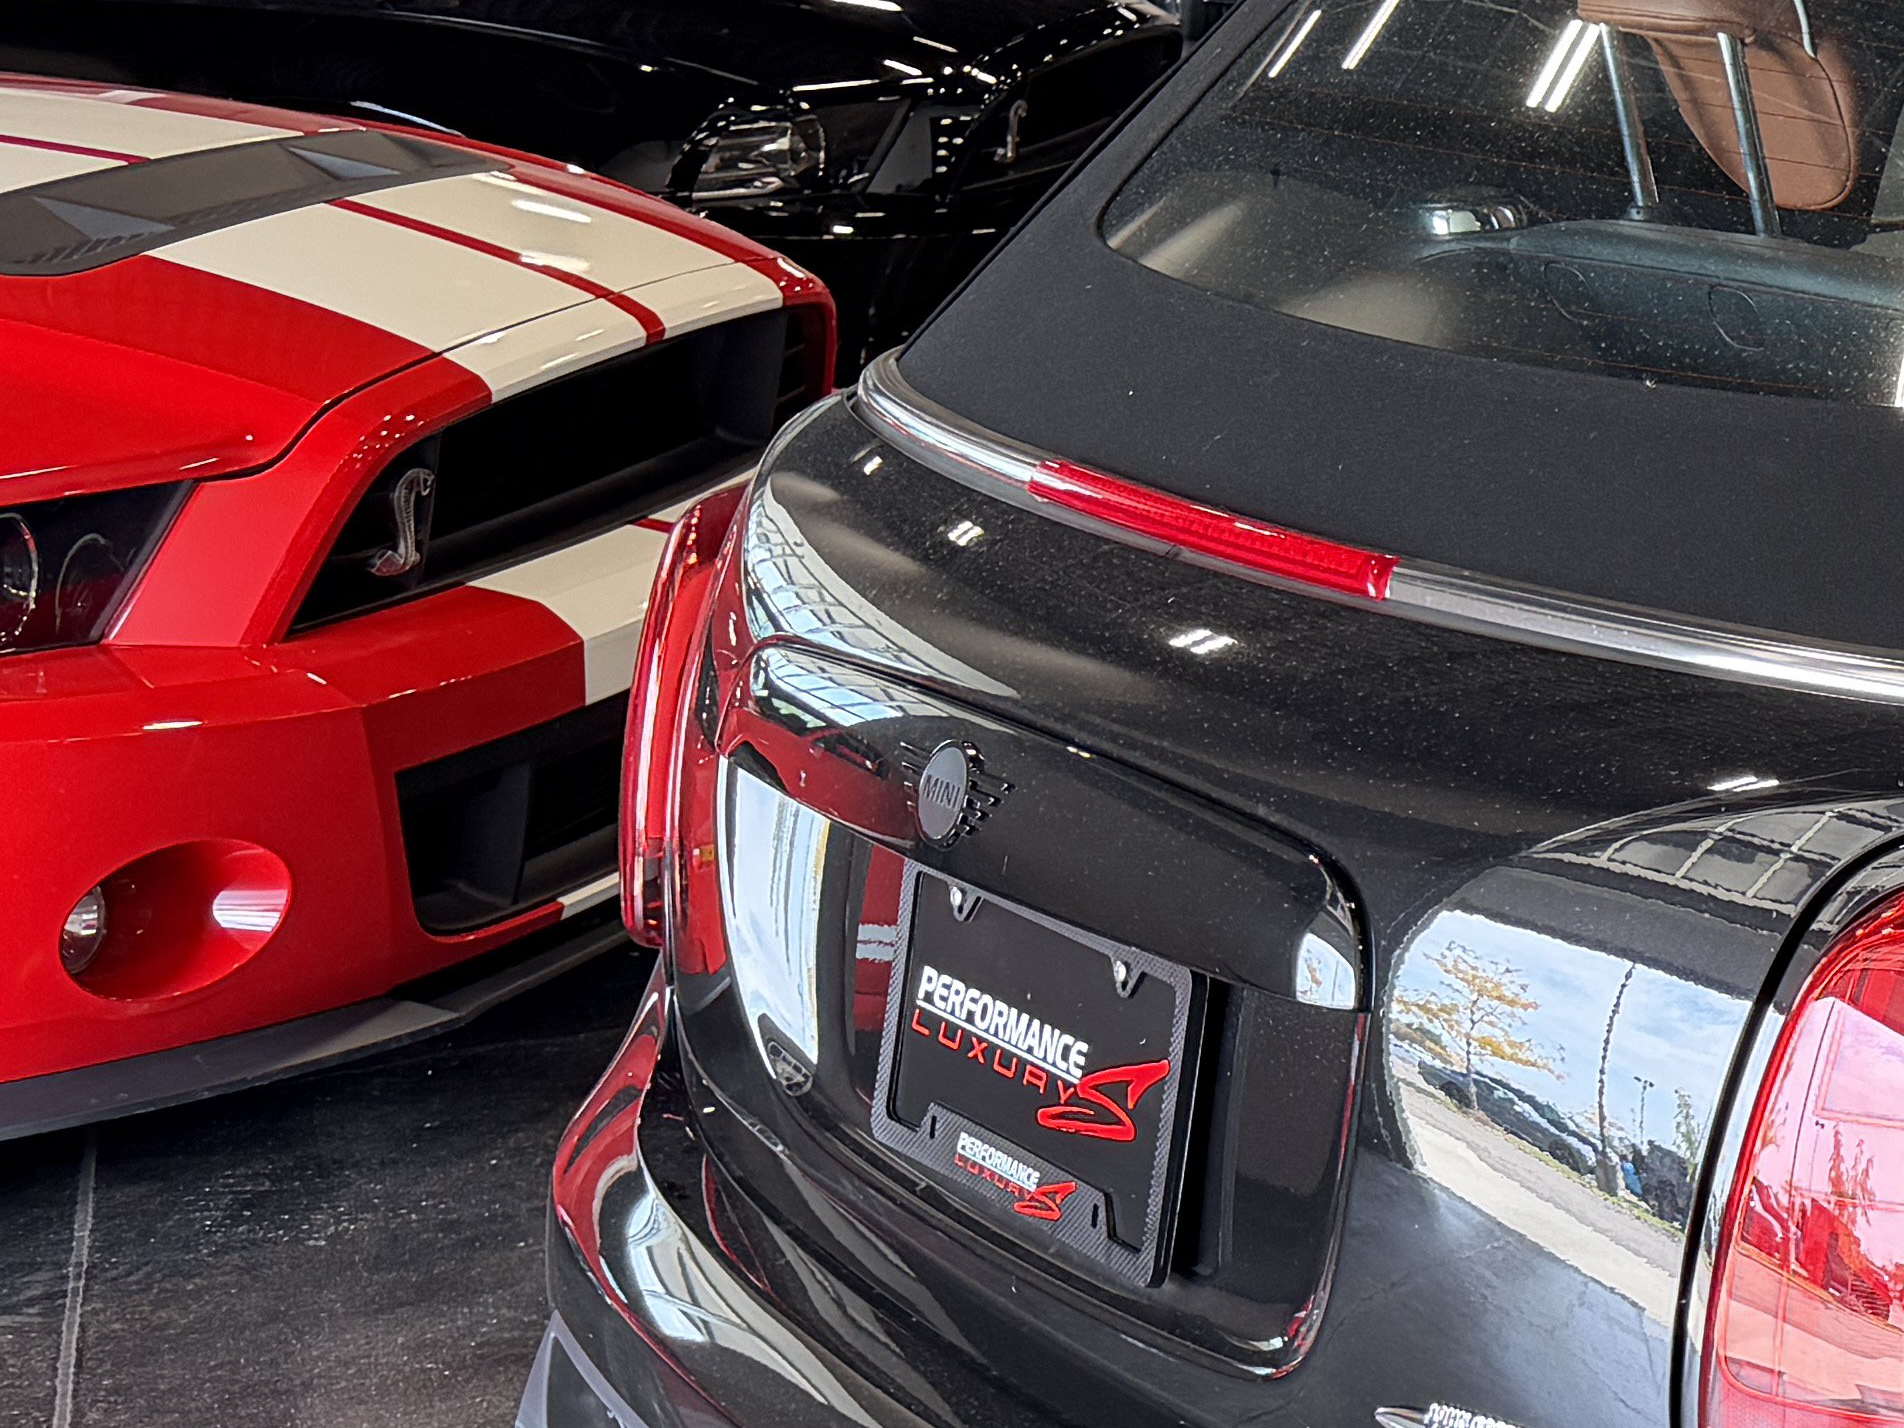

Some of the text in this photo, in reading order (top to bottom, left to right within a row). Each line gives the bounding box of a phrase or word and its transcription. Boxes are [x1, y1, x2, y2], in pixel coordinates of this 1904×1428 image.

[922, 774, 961, 809] MINI
[916, 965, 1089, 1072] PERFORMANCE
[911, 1008, 1075, 1104] LUXURY
[953, 1152, 1033, 1201] LUXURY
[957, 1131, 1041, 1185] PERFORMANCE
